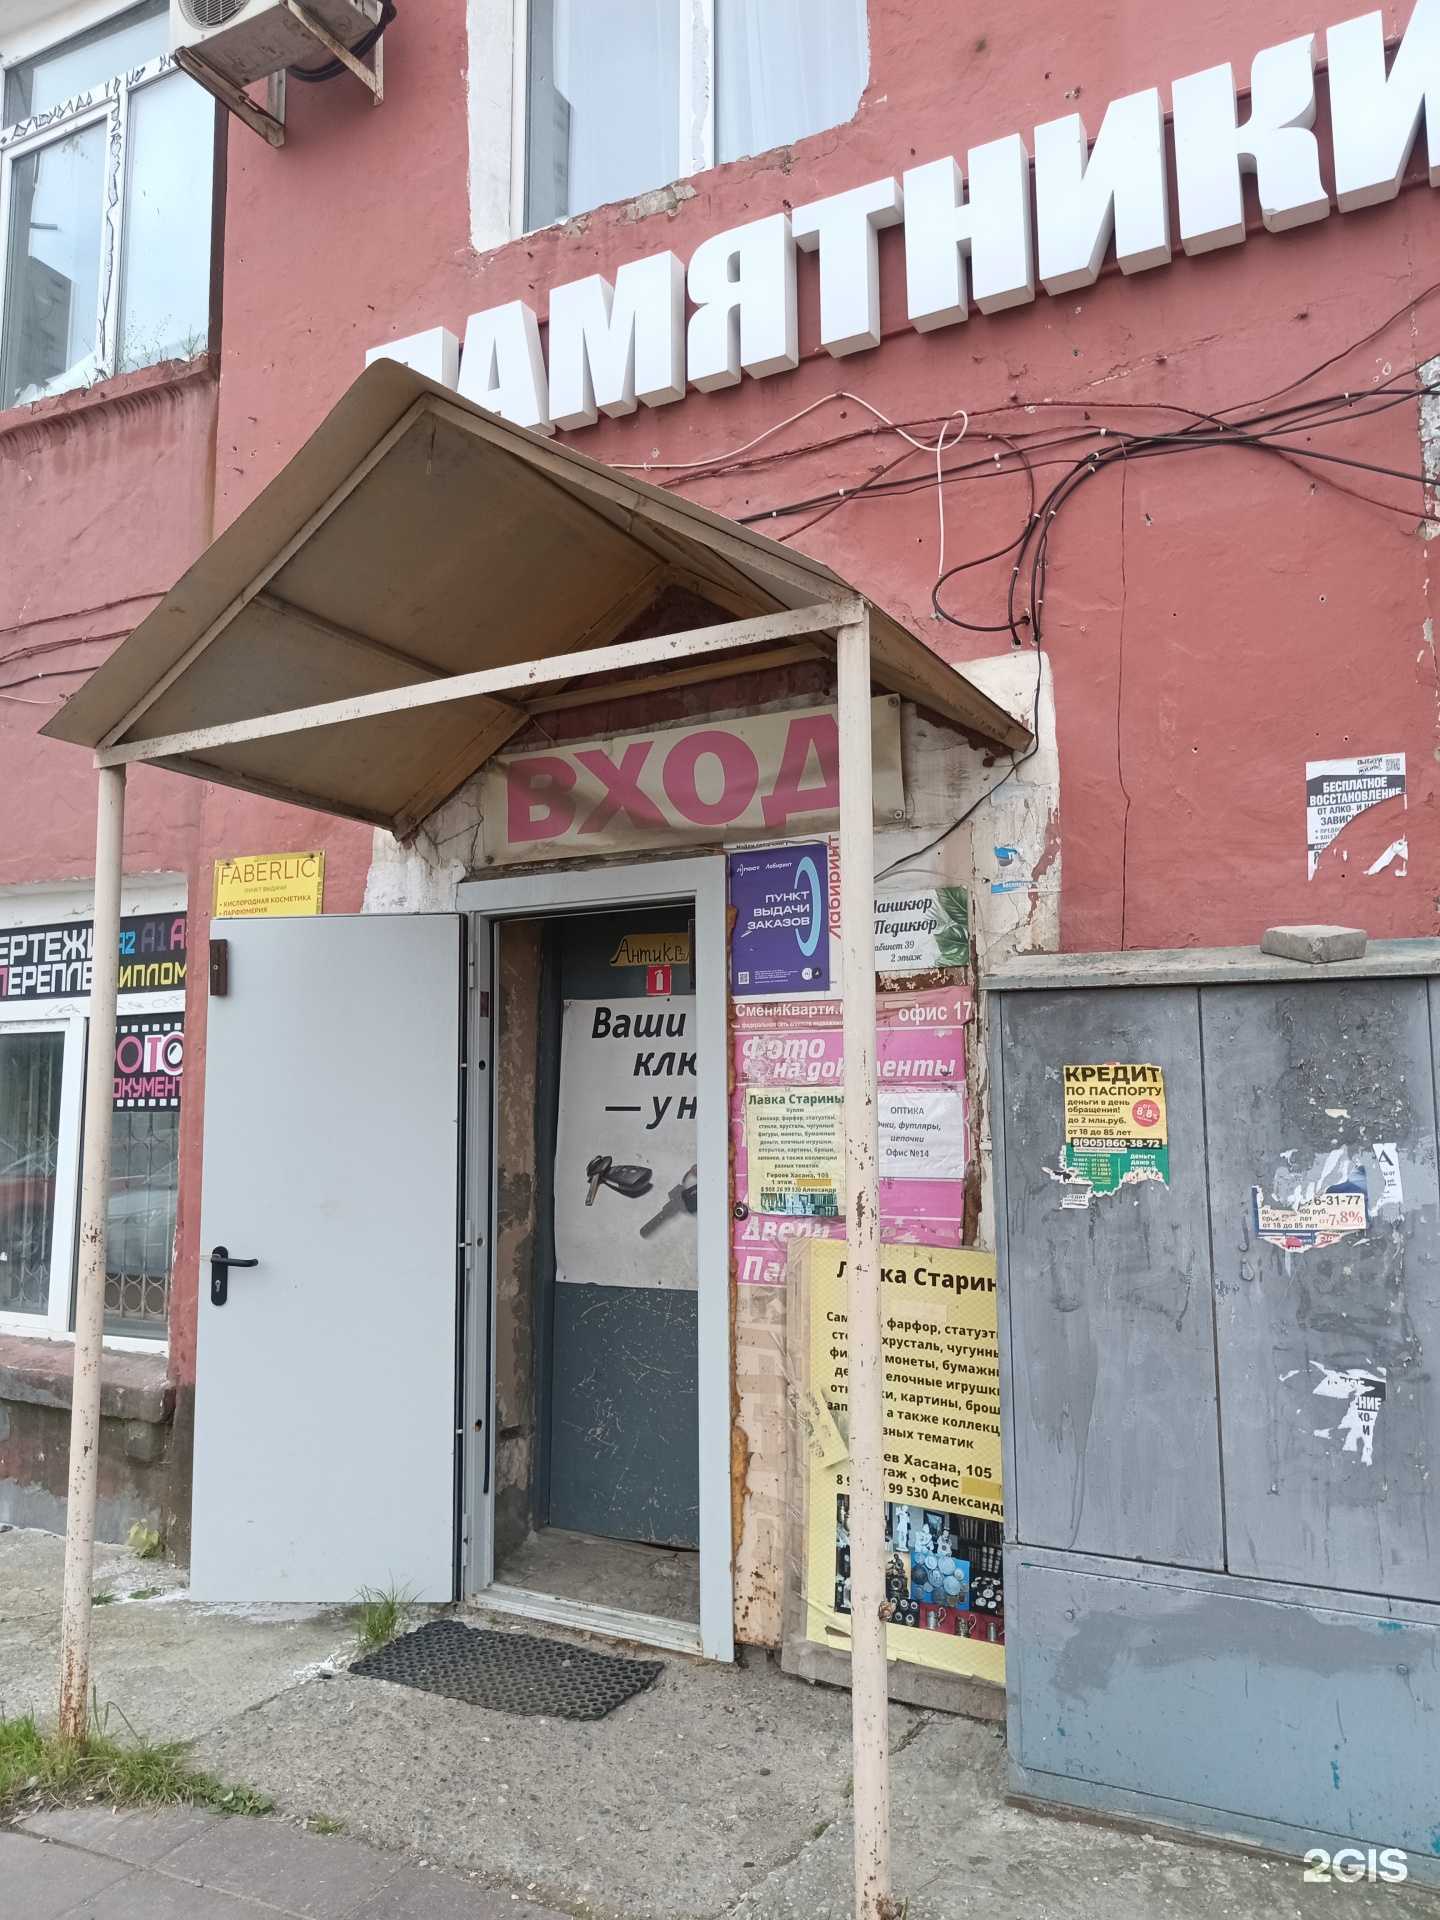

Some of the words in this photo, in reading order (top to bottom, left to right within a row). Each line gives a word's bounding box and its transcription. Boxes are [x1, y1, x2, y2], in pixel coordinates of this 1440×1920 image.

[507, 714, 840, 844] ВХОД
[1323, 776, 1388, 793] БЕСПЛАТНОЕ
[1309, 788, 1402, 806] ВОССТАНОВЛЕНИЕ
[1329, 805, 1355, 814] АЛКО-
[1320, 814, 1353, 826] ЗАВИС
[220, 859, 316, 885] FABERLIC
[828, 834, 842, 940] Лабиринт
[270, 895, 312, 903] КОСМЕТИКА
[765, 890, 810, 904] ПУНКТ
[753, 904, 810, 918] ВЫДАЧИ
[874, 898, 932, 914] аникюр
[747, 917, 810, 931] ЗАКАЗОВ
[874, 919, 938, 938] Педикюр
[904, 941, 915, 949] 39
[890, 953, 896, 962] 2
[118, 962, 187, 988] ИПЛОМ
[735, 1002, 842, 1018] СмениКварти.
[899, 1004, 947, 1023] офис
[953, 1002, 972, 1019] 17
[592, 1006, 686, 1039] Ваши
[115, 1031, 184, 1076] ОТО
[742, 1036, 826, 1058] Фото
[774, 1062, 801, 1077] на
[1064, 1066, 1160, 1085] КРЕДИТ
[1066, 1086, 1086, 1096] ПО
[1089, 1086, 1162, 1096] ПАСПОРТУ
[749, 1095, 786, 1105] Лавка
[646, 1096, 672, 1130] у
[890, 1106, 925, 1115] ОПТИКА
[1067, 1106, 1120, 1114] обращения!
[898, 1120, 941, 1133] футляры,
[1080, 1116, 1086, 1124] 2
[1088, 1117, 1127, 1125] млн.руб.
[890, 1135, 925, 1143] цепочки
[1072, 1138, 1160, 1148] 8(905)860-38-72
[886, 1148, 908, 1158] Офис
[909, 1148, 929, 1158] №14
[1328, 1210, 1363, 1227] 7,8%
[886, 1317, 941, 1335] фарфор,
[944, 1325, 998, 1340] статуэт
[882, 1336, 943, 1353] хрусталь,
[885, 1355, 939, 1371] монеты,
[942, 1360, 999, 1377] бумажн
[886, 1372, 943, 1388] елочные
[946, 1380, 1000, 1396] игрушк
[900, 1391, 962, 1410] картины,
[1356, 1395, 1382, 1412] НИЕ
[886, 1410, 894, 1418] а
[897, 1410, 939, 1425] также
[917, 1431, 975, 1449] тематик
[904, 1453, 961, 1476] Хасана,
[966, 1465, 992, 1479] 105
[836, 1474, 843, 1485] 8
[888, 1482, 903, 1495] 99
[906, 1486, 929, 1499] 530
[920, 1474, 960, 1489] офис
